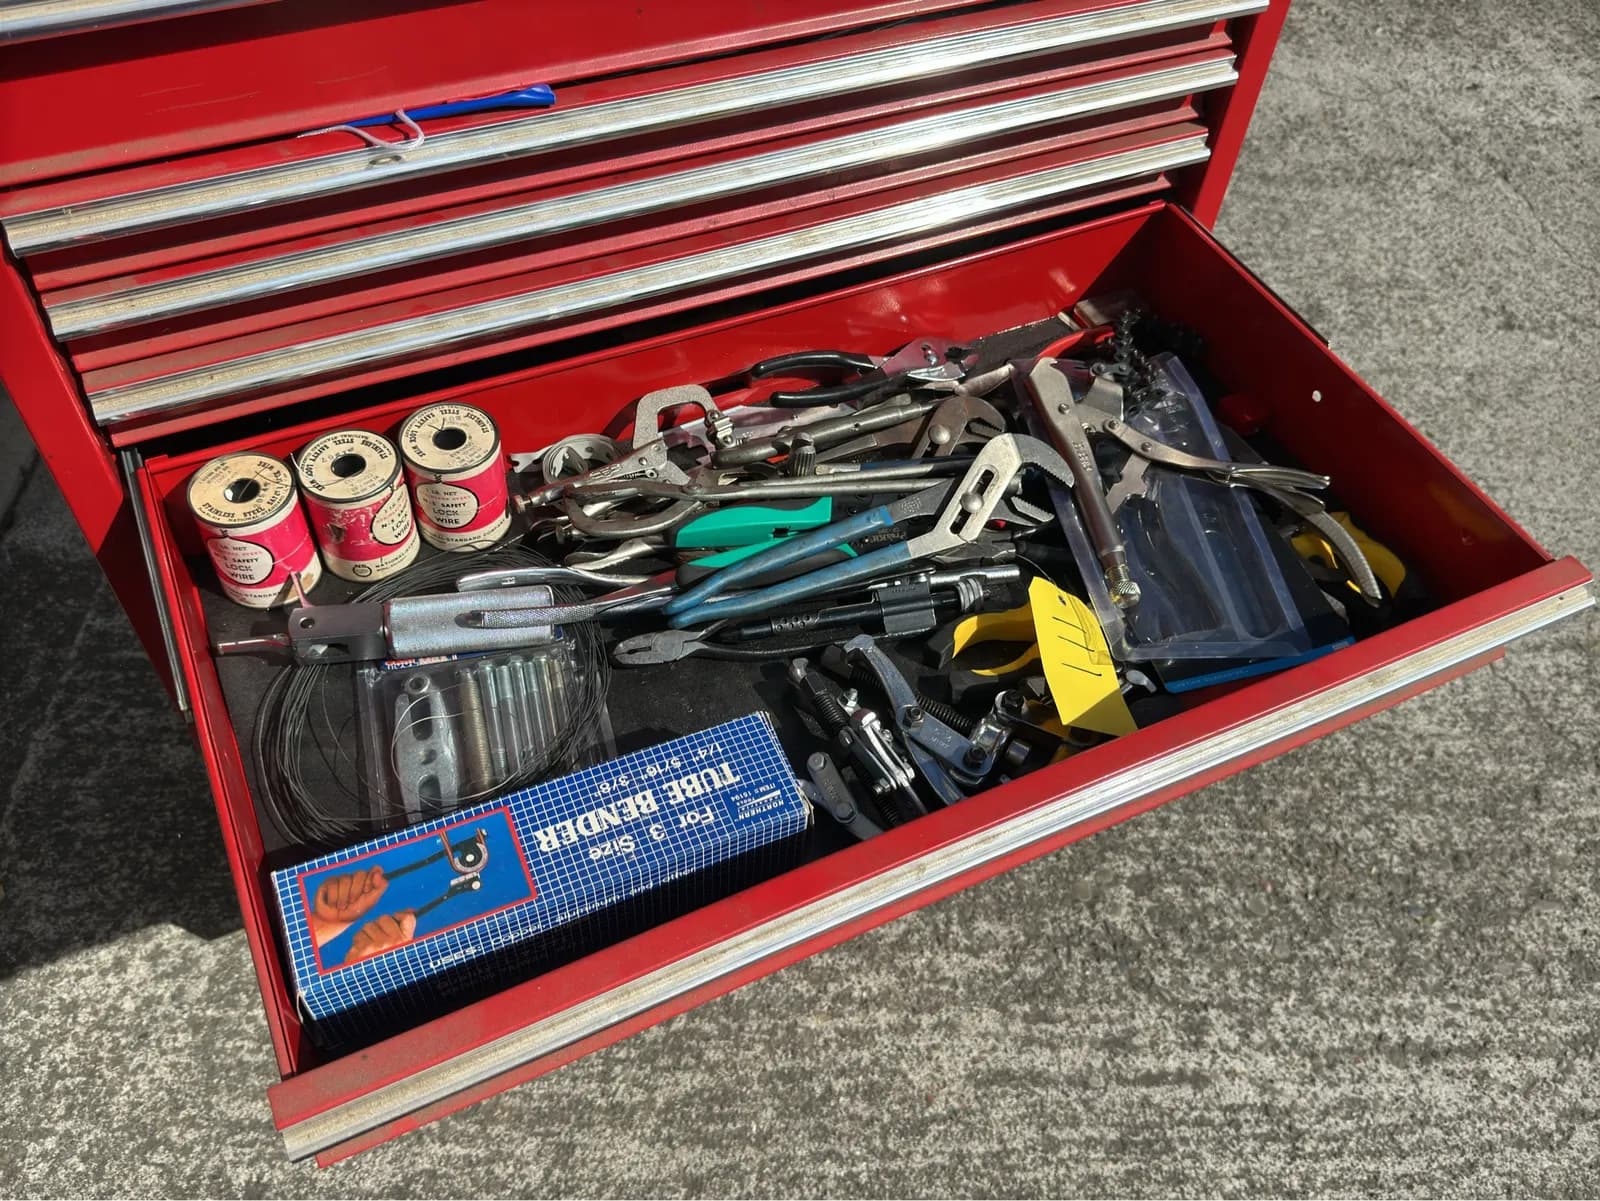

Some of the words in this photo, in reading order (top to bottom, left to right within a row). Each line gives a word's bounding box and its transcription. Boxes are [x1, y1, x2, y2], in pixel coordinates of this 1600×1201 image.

[440, 408, 460, 416] STEEL
[332, 438, 355, 446] STEEL
[243, 507, 265, 518] STEEL
[432, 507, 460, 516] LOCK
[434, 516, 460, 525] WIRE
[225, 563, 253, 572] LOCK
[230, 572, 256, 581] WIRE
[692, 742, 723, 763] 1/4"
[640, 756, 682, 781] 5/16"
[593, 774, 631, 799] 3/8"
[662, 761, 741, 805] TUBE
[679, 804, 715, 828] For
[738, 800, 785, 820] NORTHERN
[534, 791, 660, 853] BENDER
[649, 823, 665, 841] 3
[588, 834, 636, 861] Size
[491, 922, 547, 946] Copper,
[555, 893, 620, 922] aluminum
[629, 880, 654, 897] and
[661, 867, 697, 884] other
